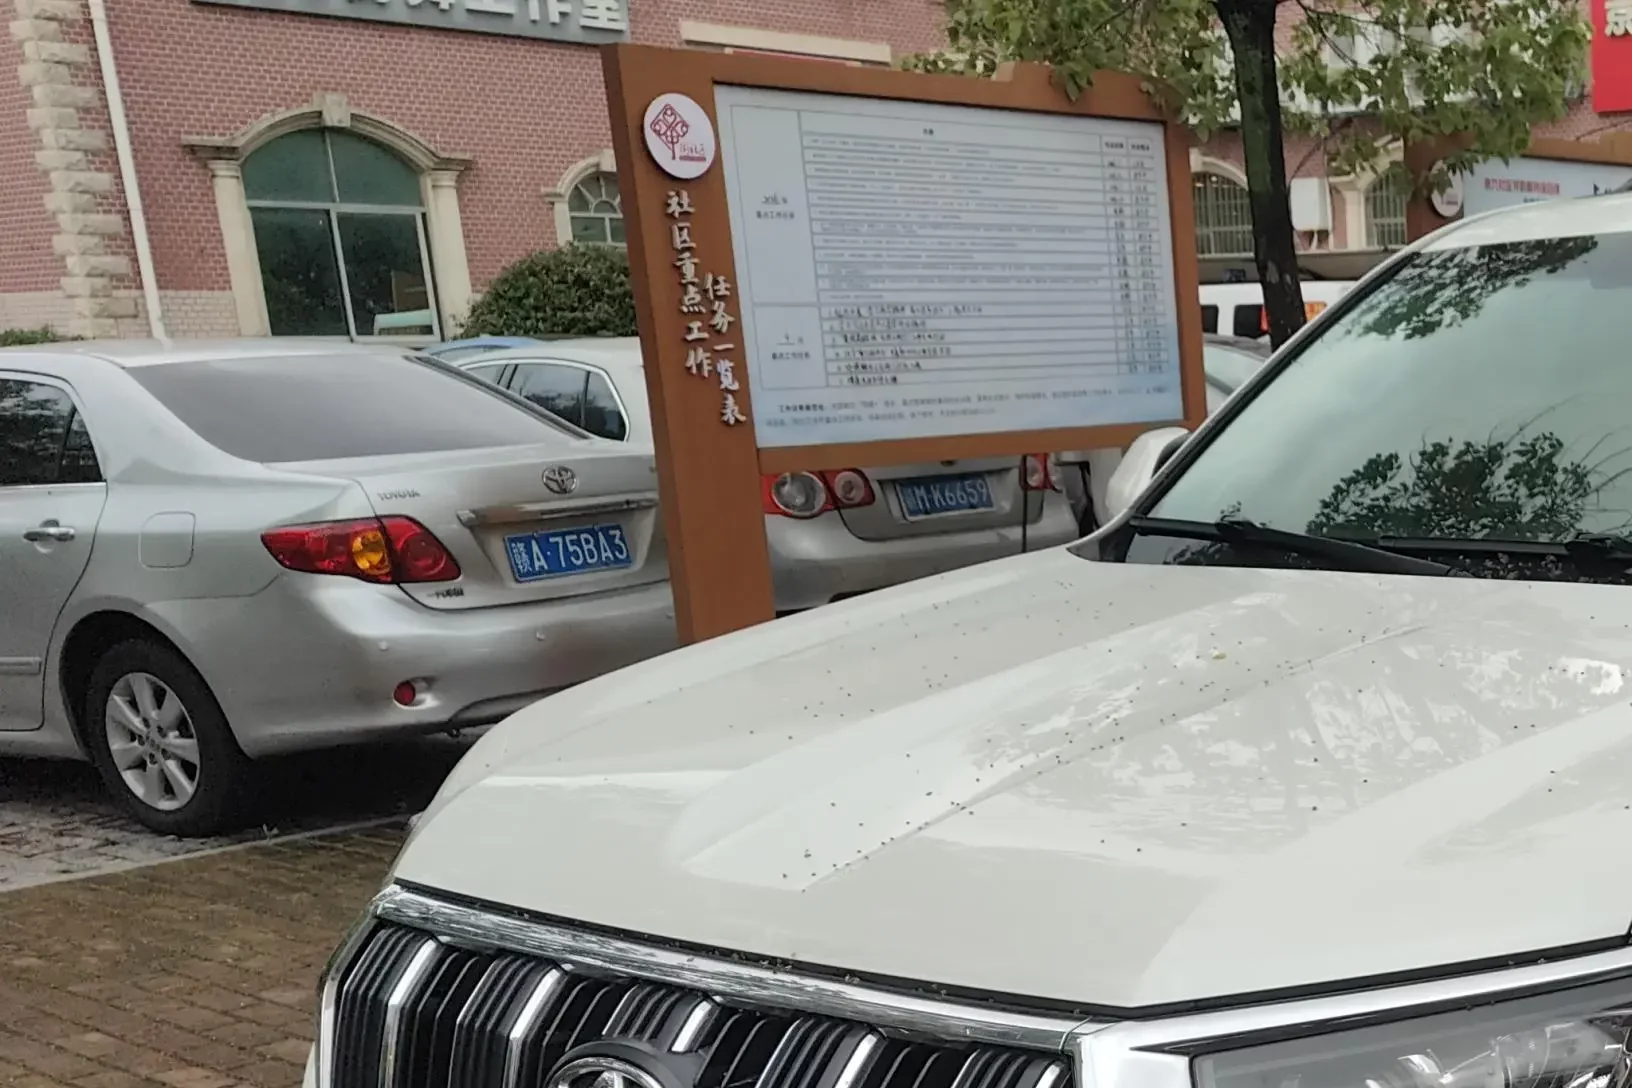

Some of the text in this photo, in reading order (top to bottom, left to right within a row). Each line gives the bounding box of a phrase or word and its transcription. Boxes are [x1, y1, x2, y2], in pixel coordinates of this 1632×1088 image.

[665, 188, 713, 378] 社区重点工作
[703, 272, 746, 426] 任务一览表
